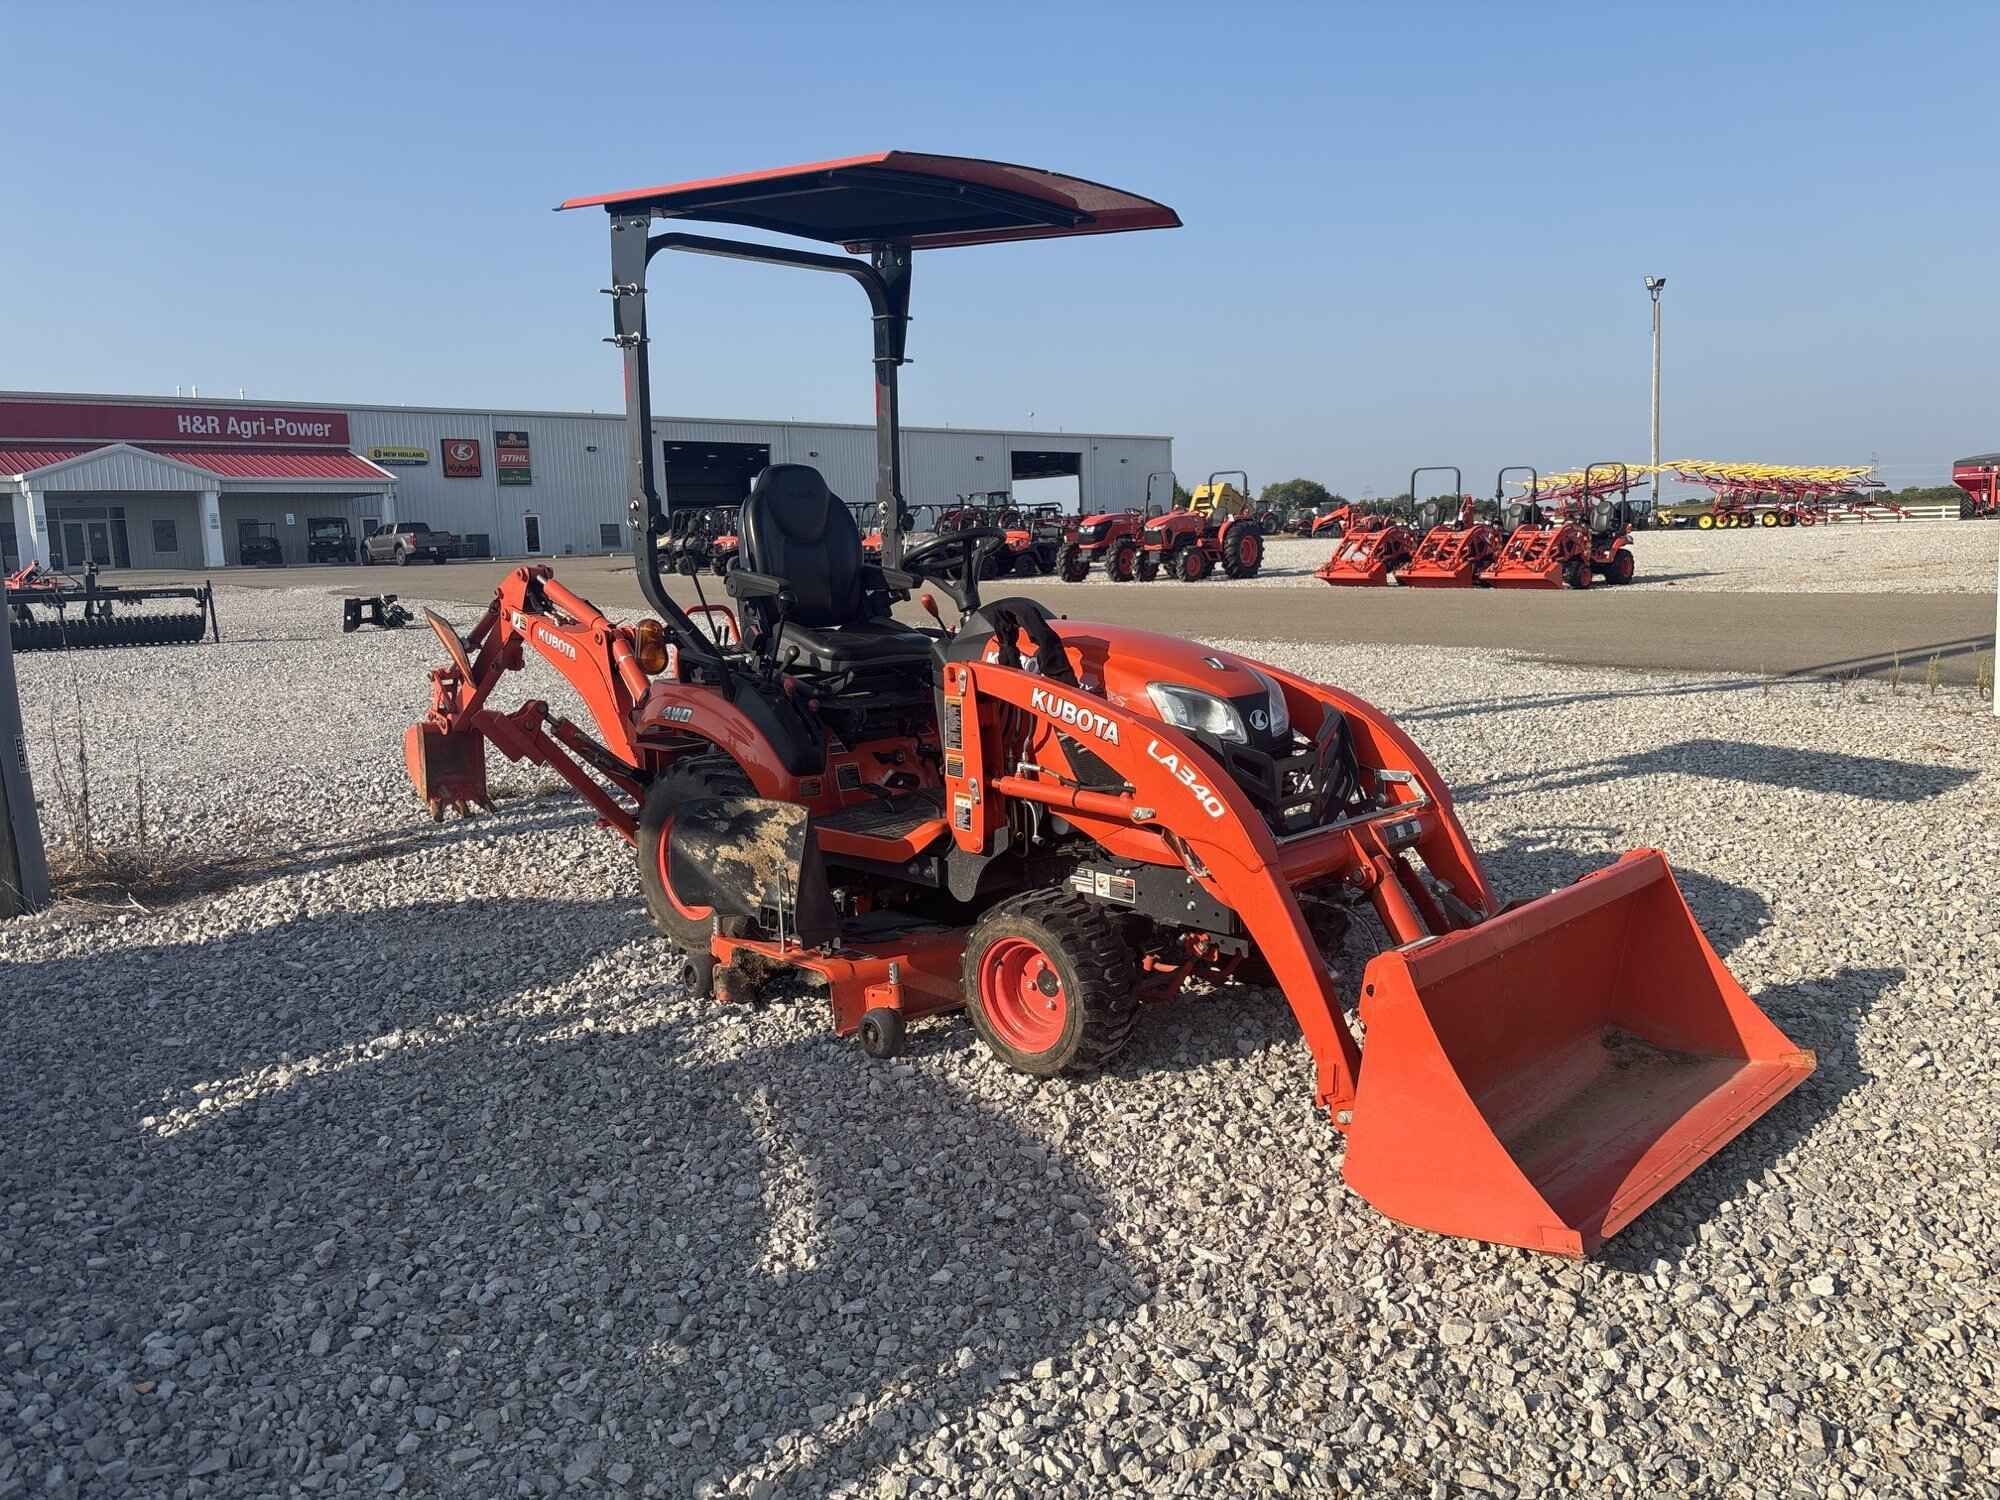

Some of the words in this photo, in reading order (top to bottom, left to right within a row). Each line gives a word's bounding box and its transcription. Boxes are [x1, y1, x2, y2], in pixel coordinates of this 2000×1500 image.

[177, 414, 221, 434] H&R
[226, 416, 332, 439] Agri-Power
[500, 454, 528, 462] STIHL
[537, 626, 577, 660] KUBOTA
[661, 706, 694, 723] 4WD
[1030, 686, 1120, 746] KUBOTA
[1145, 739, 1227, 818] LA340
